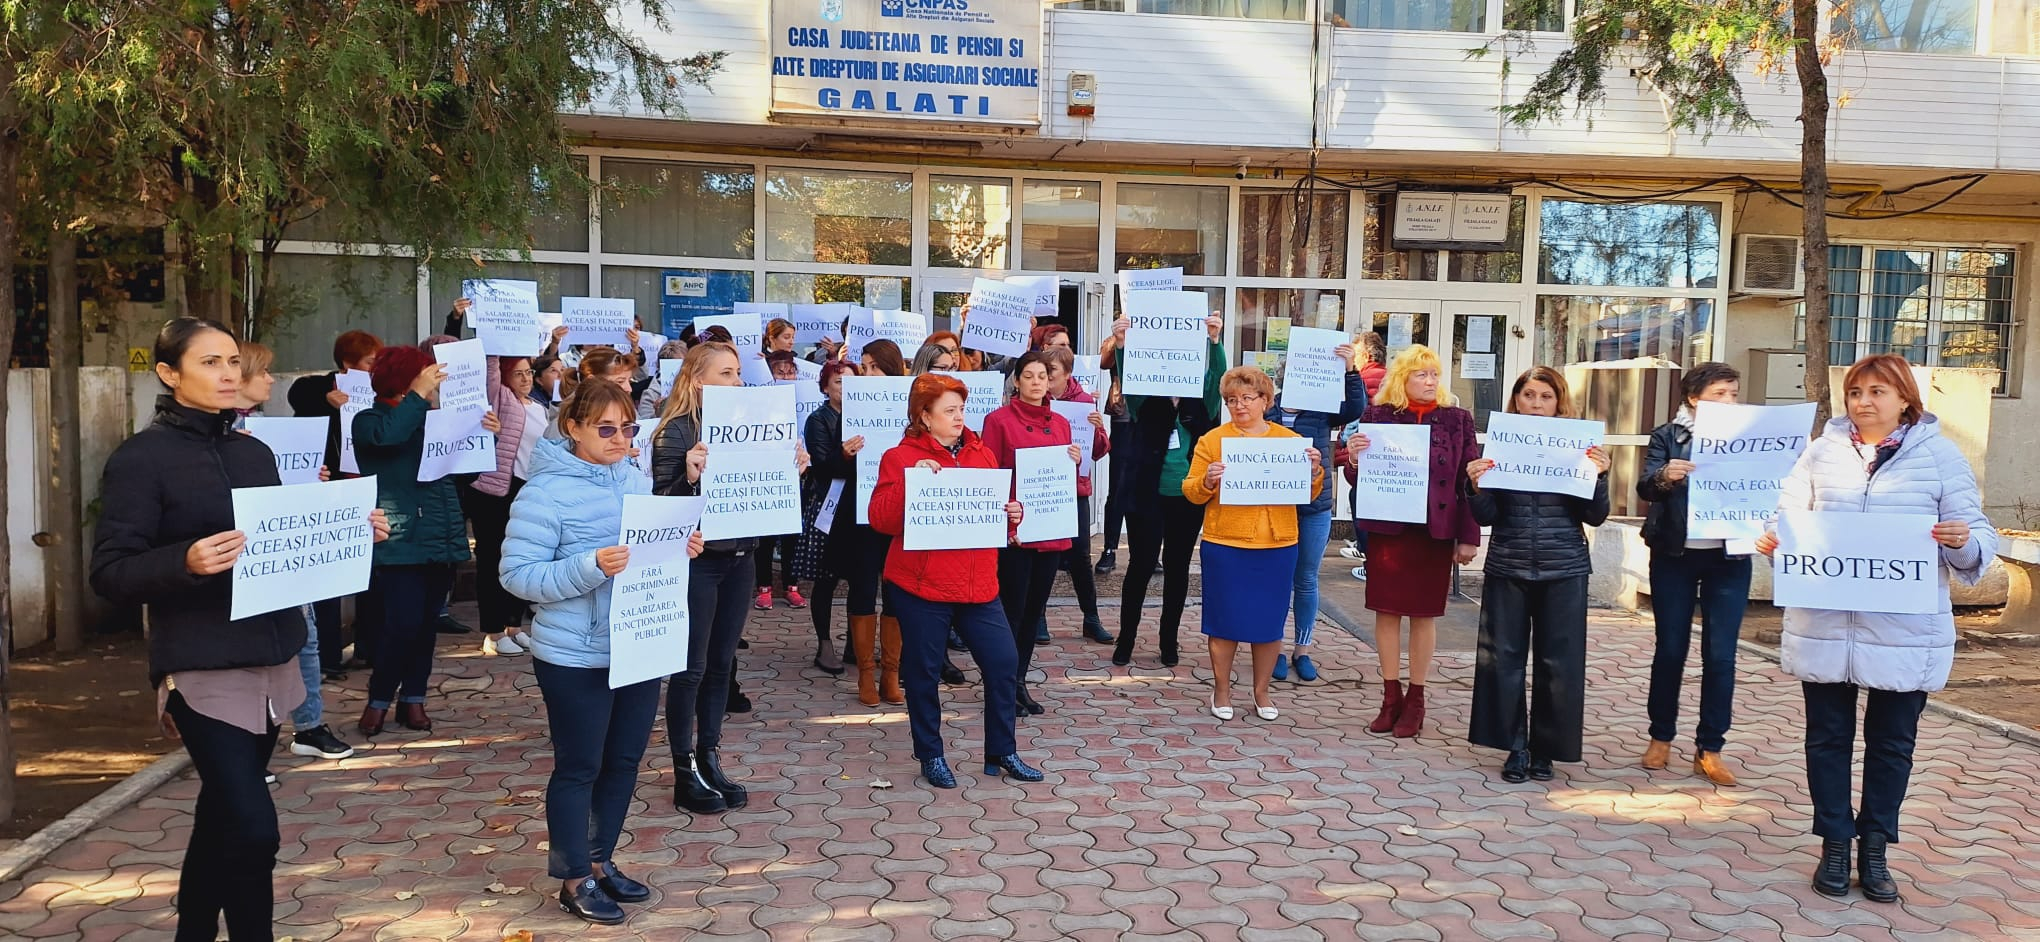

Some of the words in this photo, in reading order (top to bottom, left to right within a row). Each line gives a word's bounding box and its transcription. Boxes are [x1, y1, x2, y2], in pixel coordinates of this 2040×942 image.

[788, 27, 830, 48] CASA
[840, 29, 921, 52] JUDETEANA
[931, 34, 948, 54] DE
[957, 36, 1003, 57] PENSII
[1009, 38, 1024, 58] SI
[772, 56, 805, 76] ALTE
[809, 58, 878, 80] DREPTURI
[882, 61, 899, 81] DE
[903, 62, 979, 85] ASIGURARI
[982, 66, 1038, 87] SOCIALE
[818, 88, 989, 116] GALATI
[796, 321, 841, 331] PROTES
[1130, 315, 1204, 331] PROTEST
[570, 326, 598, 334] CELAȘI
[967, 323, 1026, 344] PROTEST
[1128, 350, 1165, 360] MUNCĂ
[1167, 351, 1201, 361] EGALĂ
[1294, 366, 1336, 375] SALARIZAREA
[1126, 373, 1165, 383] SALARII
[1168, 375, 1200, 385] EGALE
[846, 390, 889, 402] MUNCĂ
[846, 417, 891, 428] SALARII
[708, 422, 796, 444] PROTEST
[1490, 430, 1543, 447] MUNCĂ
[1548, 436, 1595, 450] EGALĂ
[1698, 435, 1804, 455] PROTEST
[1226, 452, 1268, 463] MUNCĂ
[1271, 452, 1307, 463] EGALĂ
[1366, 454, 1420, 462] DISCRIMINARE
[1388, 461, 1397, 469] ÎN
[712, 472, 756, 484] ACEEAȘI
[759, 471, 787, 482] LEGE,
[1367, 469, 1418, 478] SALARIZAREA
[1489, 462, 1541, 476] ALARII
[1544, 466, 1591, 481] EGALE
[1023, 474, 1067, 484] DISCRIMINARE
[1225, 480, 1269, 490] SALARII
[1271, 480, 1307, 490] EGALE
[1360, 477, 1424, 487] FUNCȚIONARILOR
[1695, 479, 1746, 491] MUNCĂ
[1749, 480, 1784, 491] EGAL
[706, 487, 748, 499] ACEEAȘI
[750, 484, 797, 497] FUNCȚIE,
[918, 487, 963, 498] ACEEAȘI
[965, 487, 996, 497] LEGE,
[1024, 490, 1069, 499] SALARIZAREA
[1377, 486, 1406, 494] PUBLICI
[704, 501, 748, 514] ACELAȘI
[751, 498, 796, 511] SALARIU
[909, 501, 954, 512] ACEEAȘI
[1023, 496, 1074, 508] UNCȚIONARILOR
[1034, 507, 1060, 515] PUBLICI
[1694, 510, 1747, 521] SALARII
[256, 512, 323, 534] ACEEAȘI
[325, 506, 361, 525] LEGE,
[909, 514, 955, 527] ACELAȘI
[957, 514, 1003, 525] SALARIU
[625, 524, 695, 545] PROTEST
[239, 535, 308, 558] ACEEAȘI
[310, 524, 369, 547] FUNCȚIE,
[239, 556, 305, 580] ACELAȘI
[308, 543, 367, 567] SALARIU
[1780, 553, 1929, 582] PROTEST
[641, 565, 663, 579] FĂRĂ
[622, 576, 679, 594] DISCRIMINARE
[646, 591, 656, 602] ÎN
[620, 601, 677, 618] SALARIZAREA
[613, 611, 685, 633] FUNCȚIONARILOR
[634, 626, 668, 641] PUBLICI
